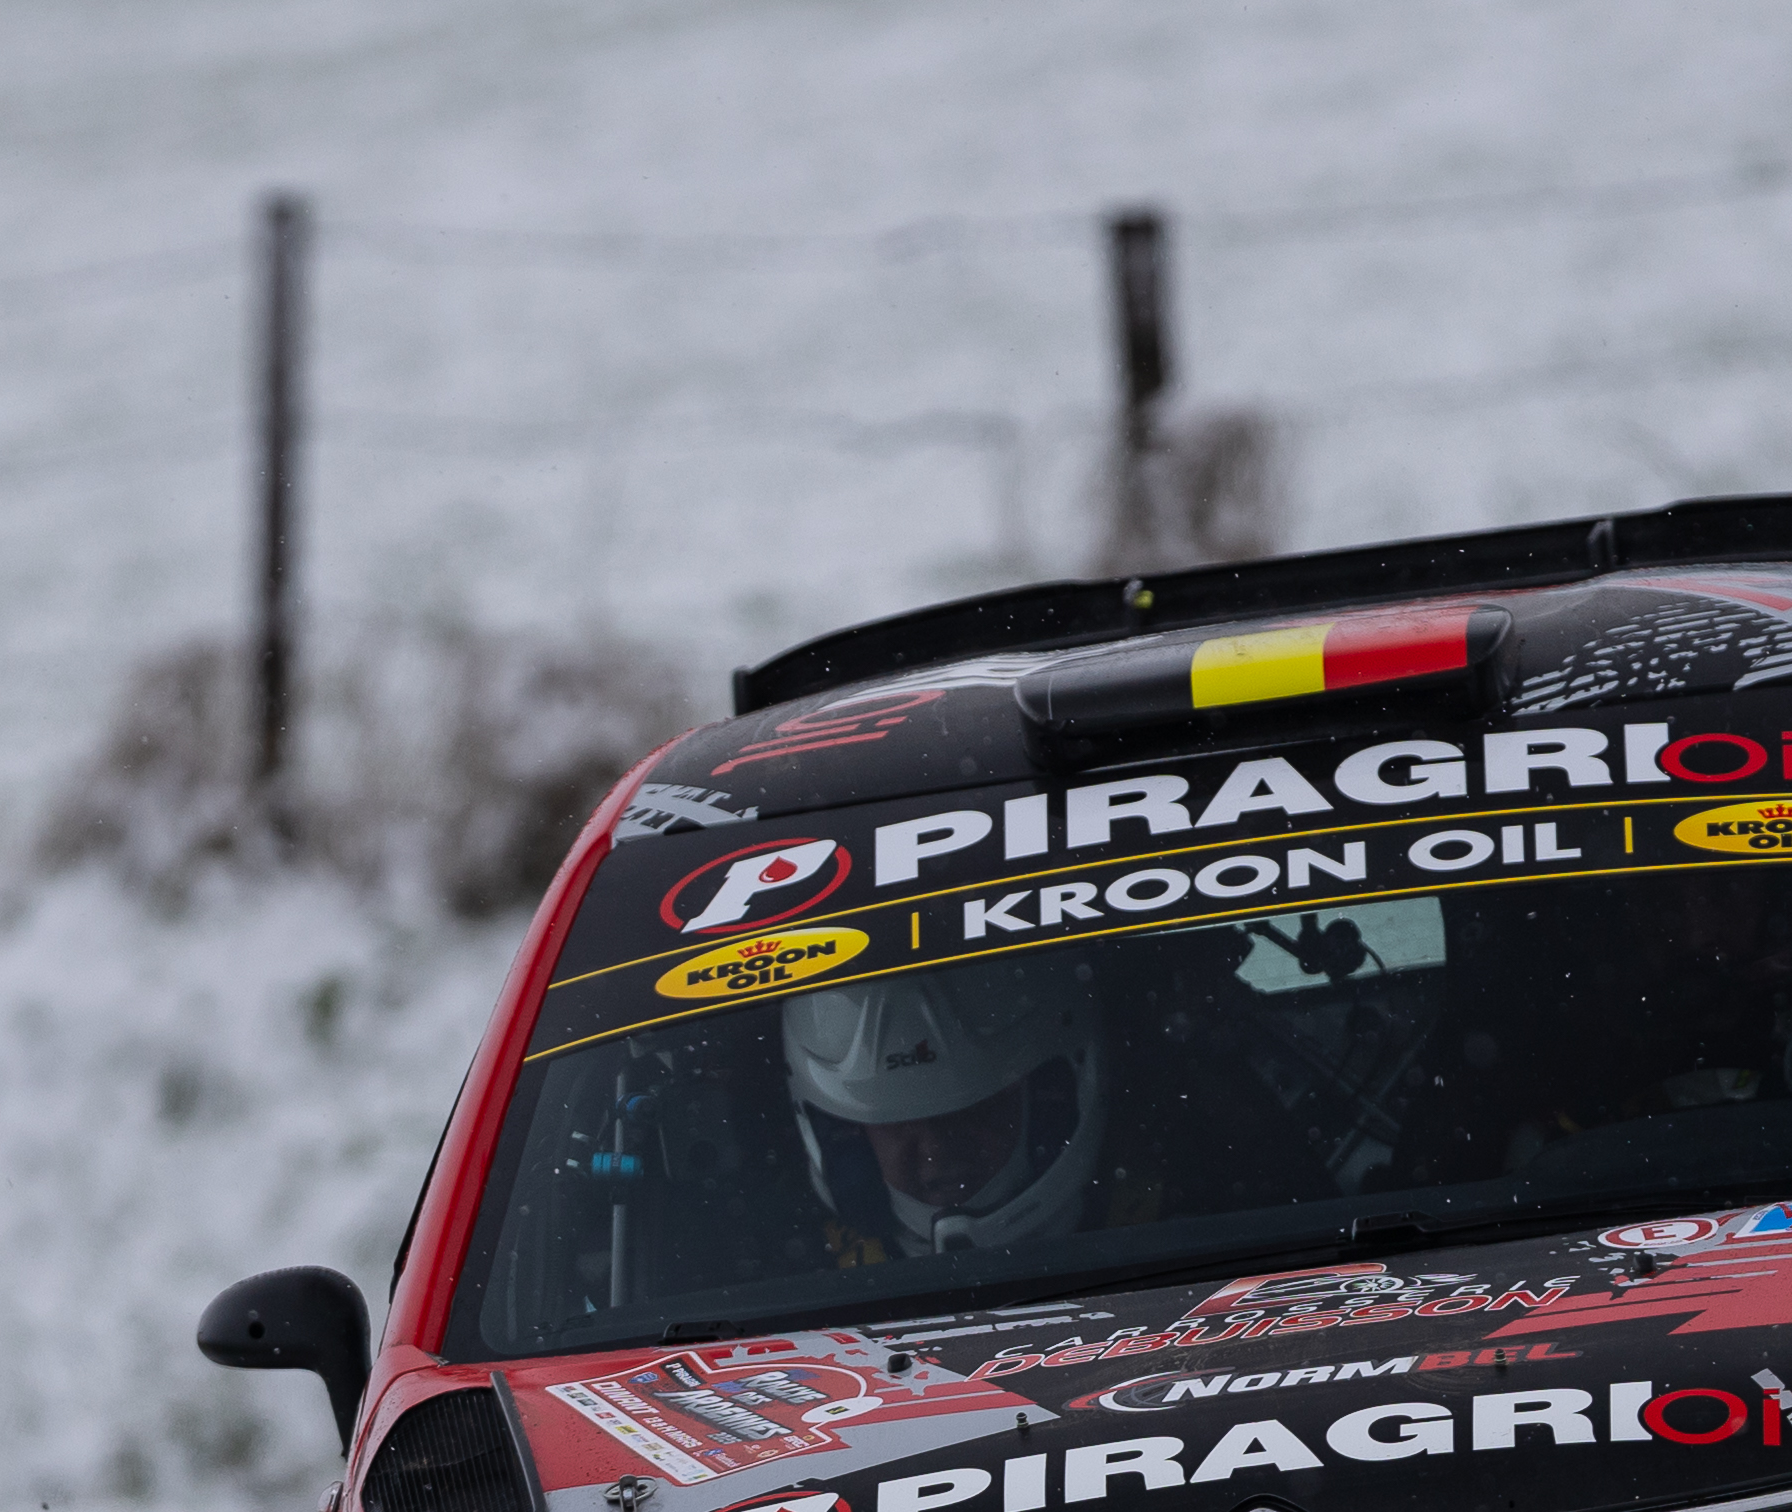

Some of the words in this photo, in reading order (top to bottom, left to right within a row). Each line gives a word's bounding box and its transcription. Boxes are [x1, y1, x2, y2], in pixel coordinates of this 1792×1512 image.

[964, 840, 1367, 940] KROON
[1408, 821, 1582, 872] OIL
[687, 939, 837, 986] KROON
[727, 965, 793, 990] OIL
[1640, 1223, 1677, 1241] E
[964, 1287, 1576, 1382] DEBUISSON
[995, 1275, 1582, 1359] CARROSSERIE
[591, 1380, 660, 1415] DINANT
[1163, 1344, 1579, 1402] NORMBEL
[654, 1389, 794, 1440] ARDENNES
